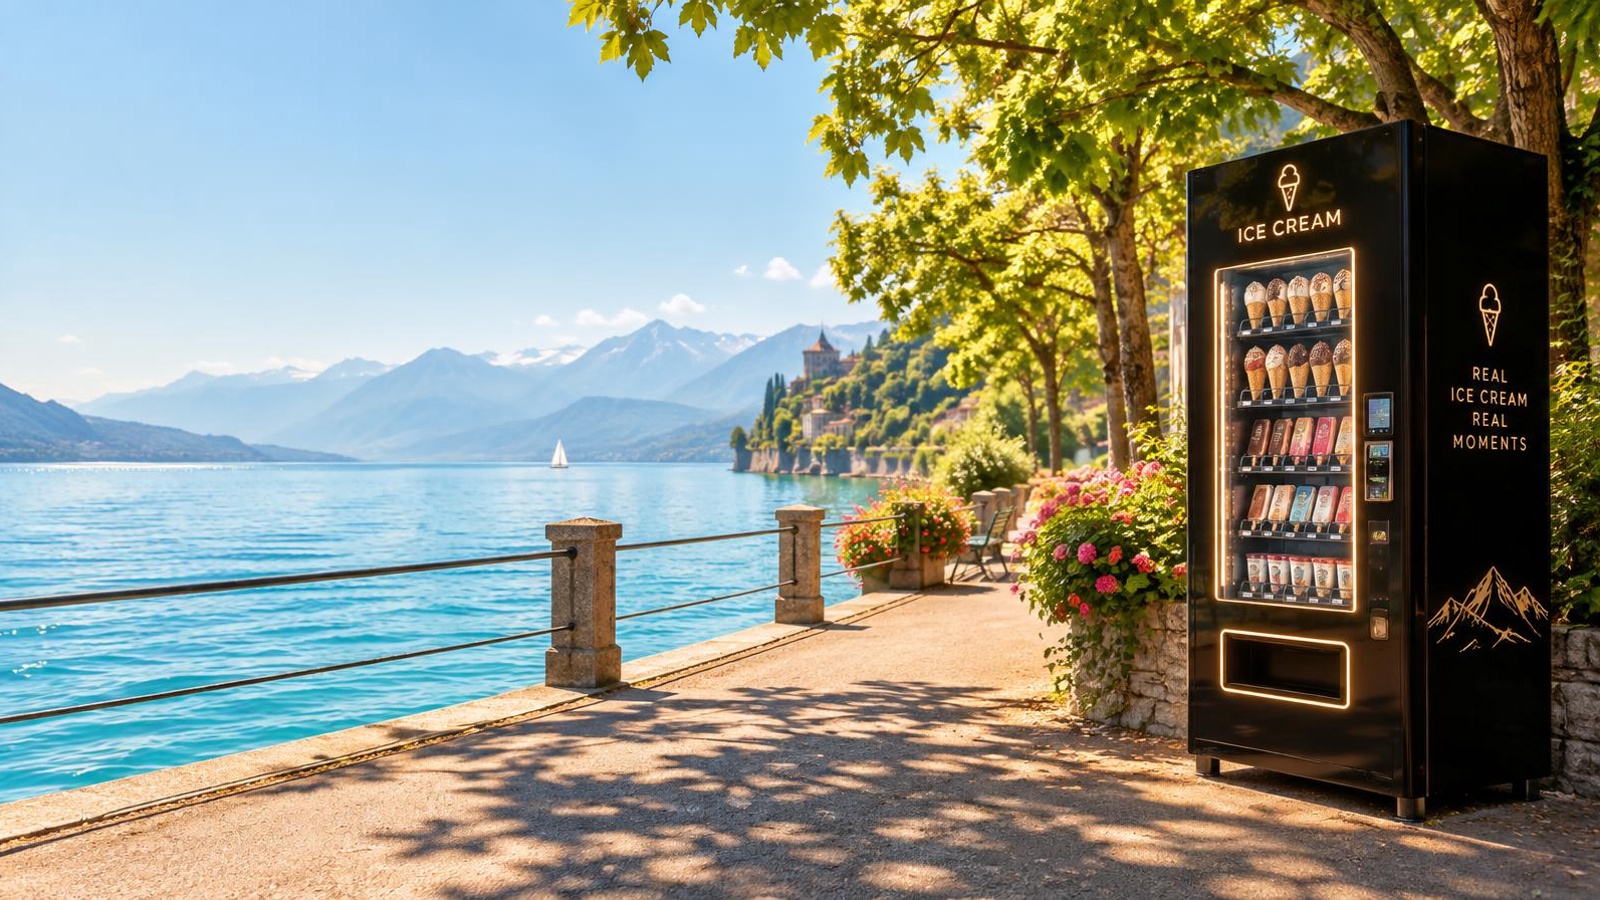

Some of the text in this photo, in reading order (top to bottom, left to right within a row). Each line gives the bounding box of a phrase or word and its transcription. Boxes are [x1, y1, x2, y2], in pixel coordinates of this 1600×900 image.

[1238, 209, 1342, 243] ICE CREAM
[1472, 366, 1508, 384] REAL
[1451, 386, 1528, 408] ICE CREAM
[1472, 411, 1508, 428] REAL
[1453, 434, 1527, 451] MOMENTS
